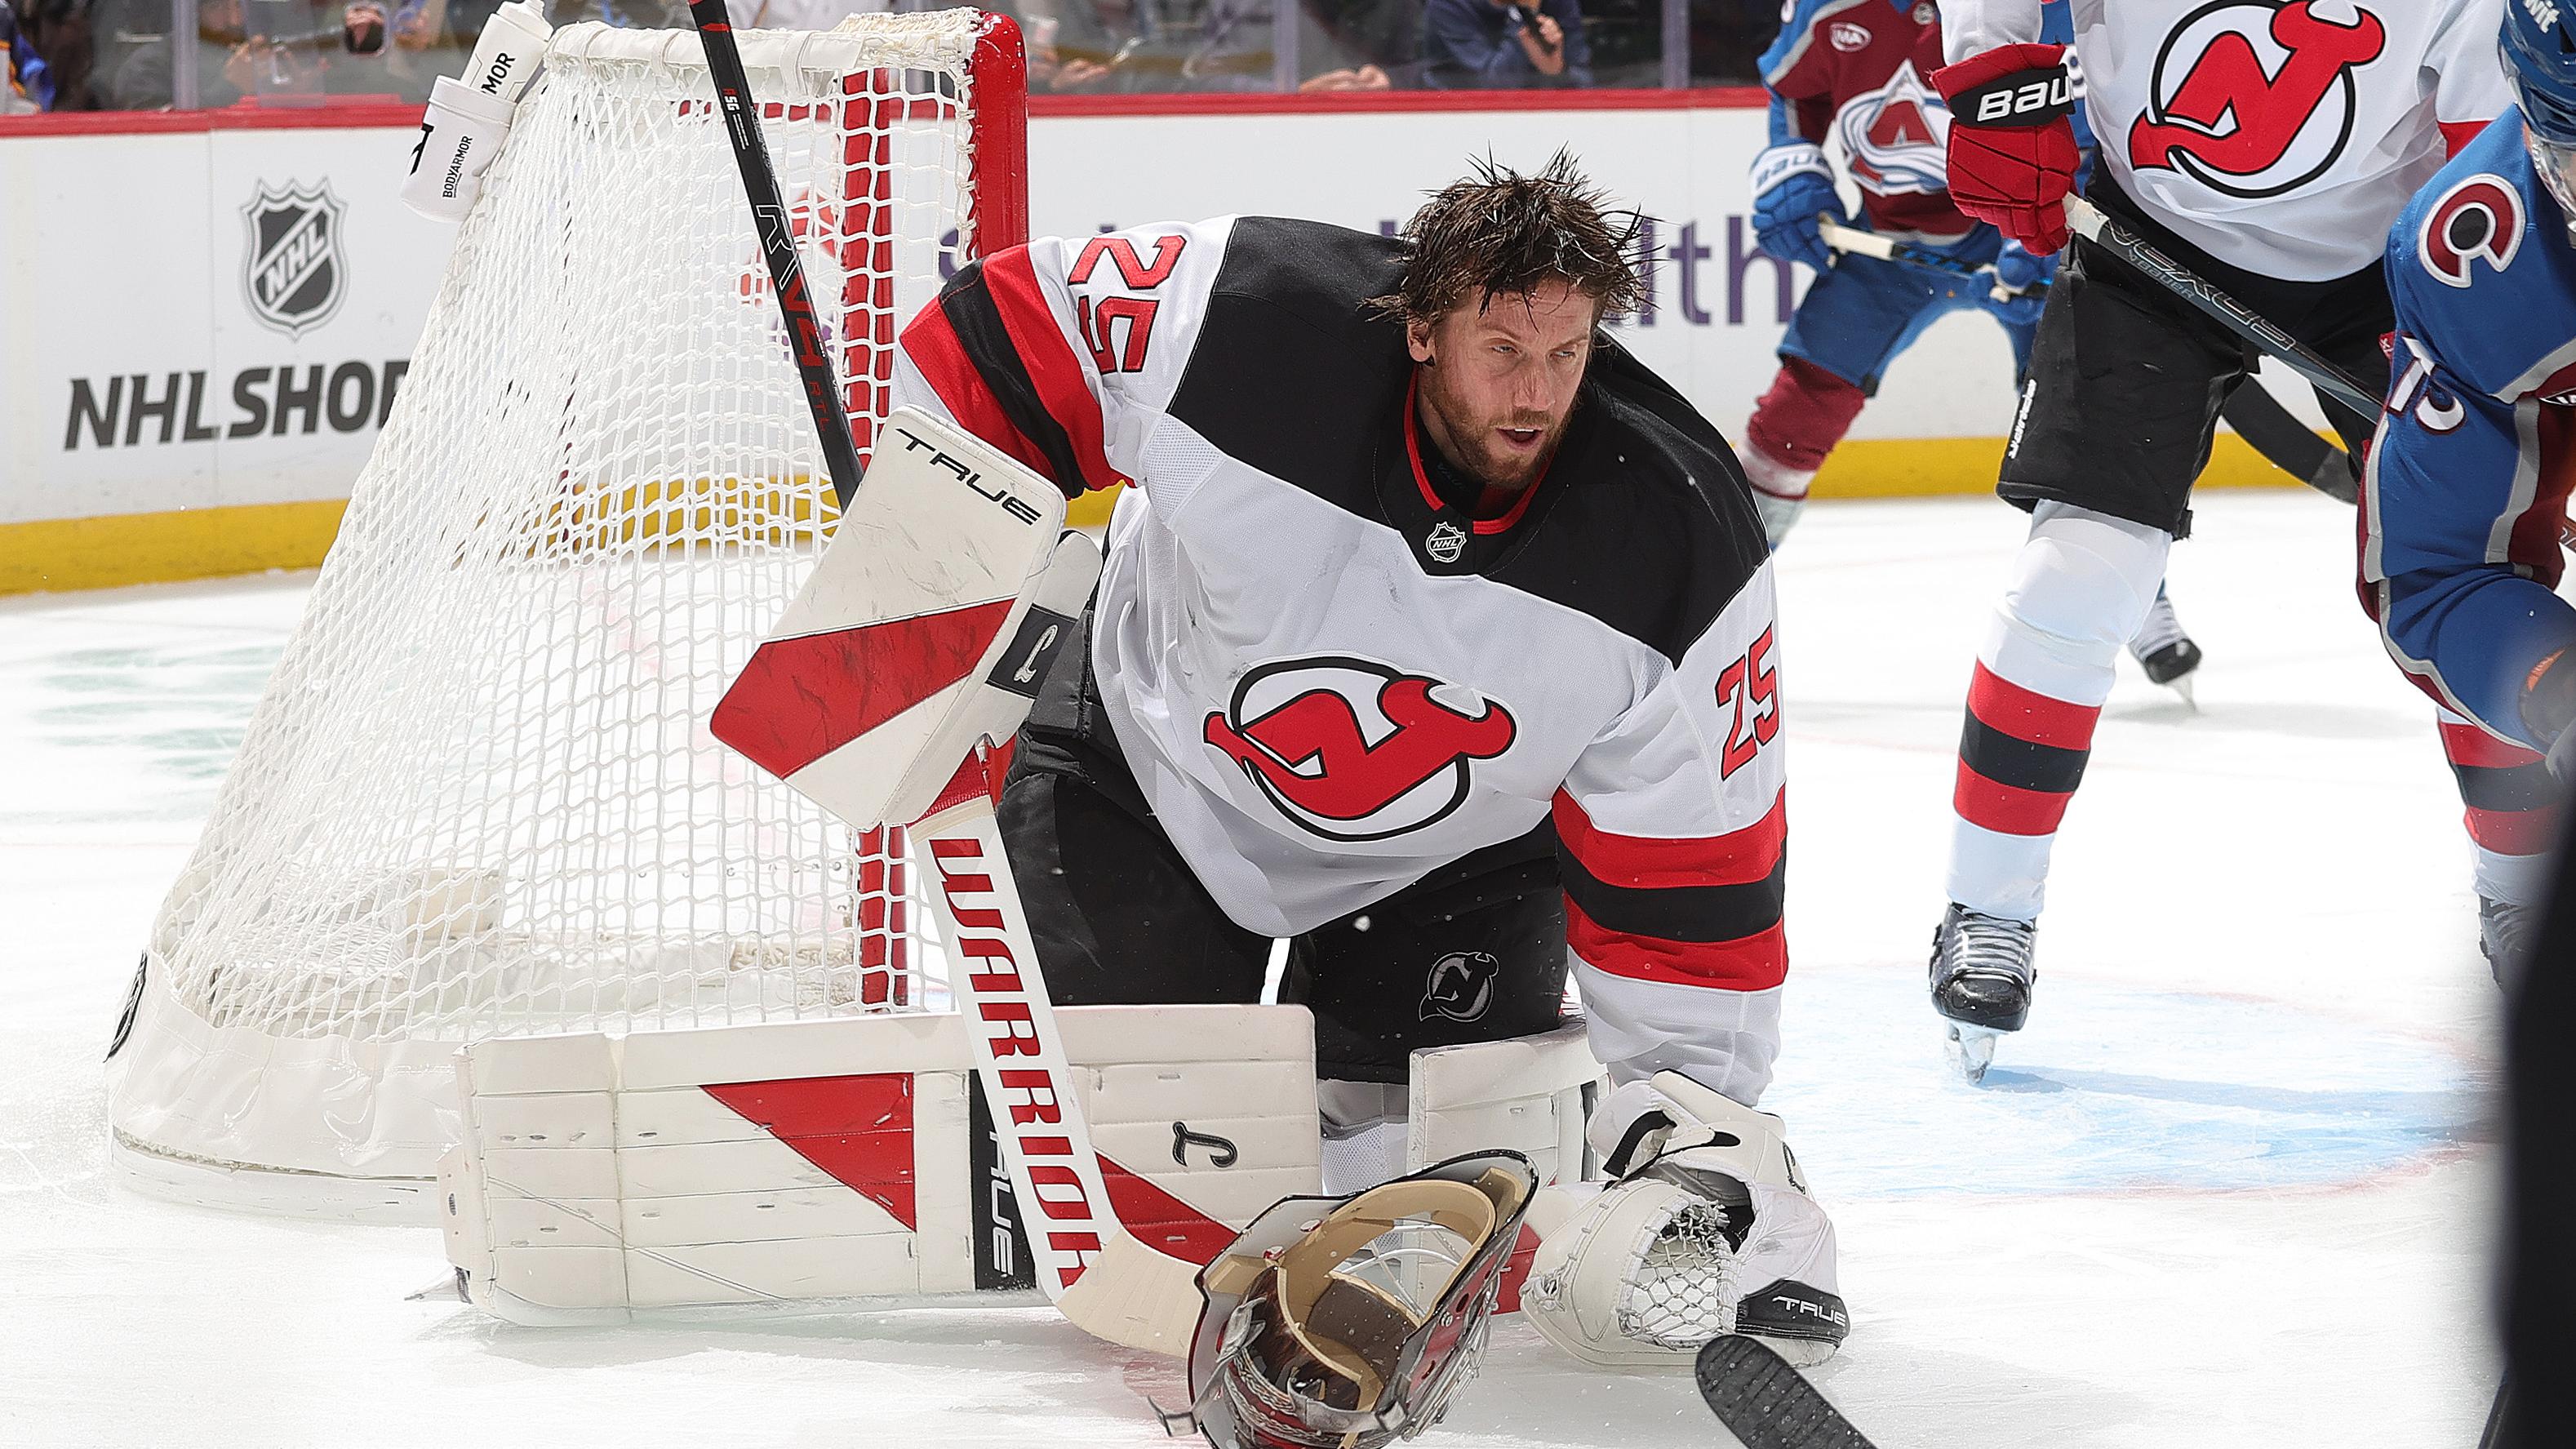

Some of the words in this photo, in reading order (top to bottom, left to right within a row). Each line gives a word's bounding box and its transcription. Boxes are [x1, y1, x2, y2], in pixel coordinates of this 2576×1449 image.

[481, 52, 516, 95] MOR
[442, 136, 473, 198] BODYARMOR
[264, 220, 326, 303] NHL
[1068, 235, 1187, 375] 25
[895, 427, 1042, 527] TRUE
[1432, 539, 1458, 549] NHL
[1715, 620, 1780, 782] 25
[928, 838, 1102, 1291] WARRIOR
[988, 1131, 1015, 1276] RUE
[1772, 1296, 1846, 1327] TRUE
